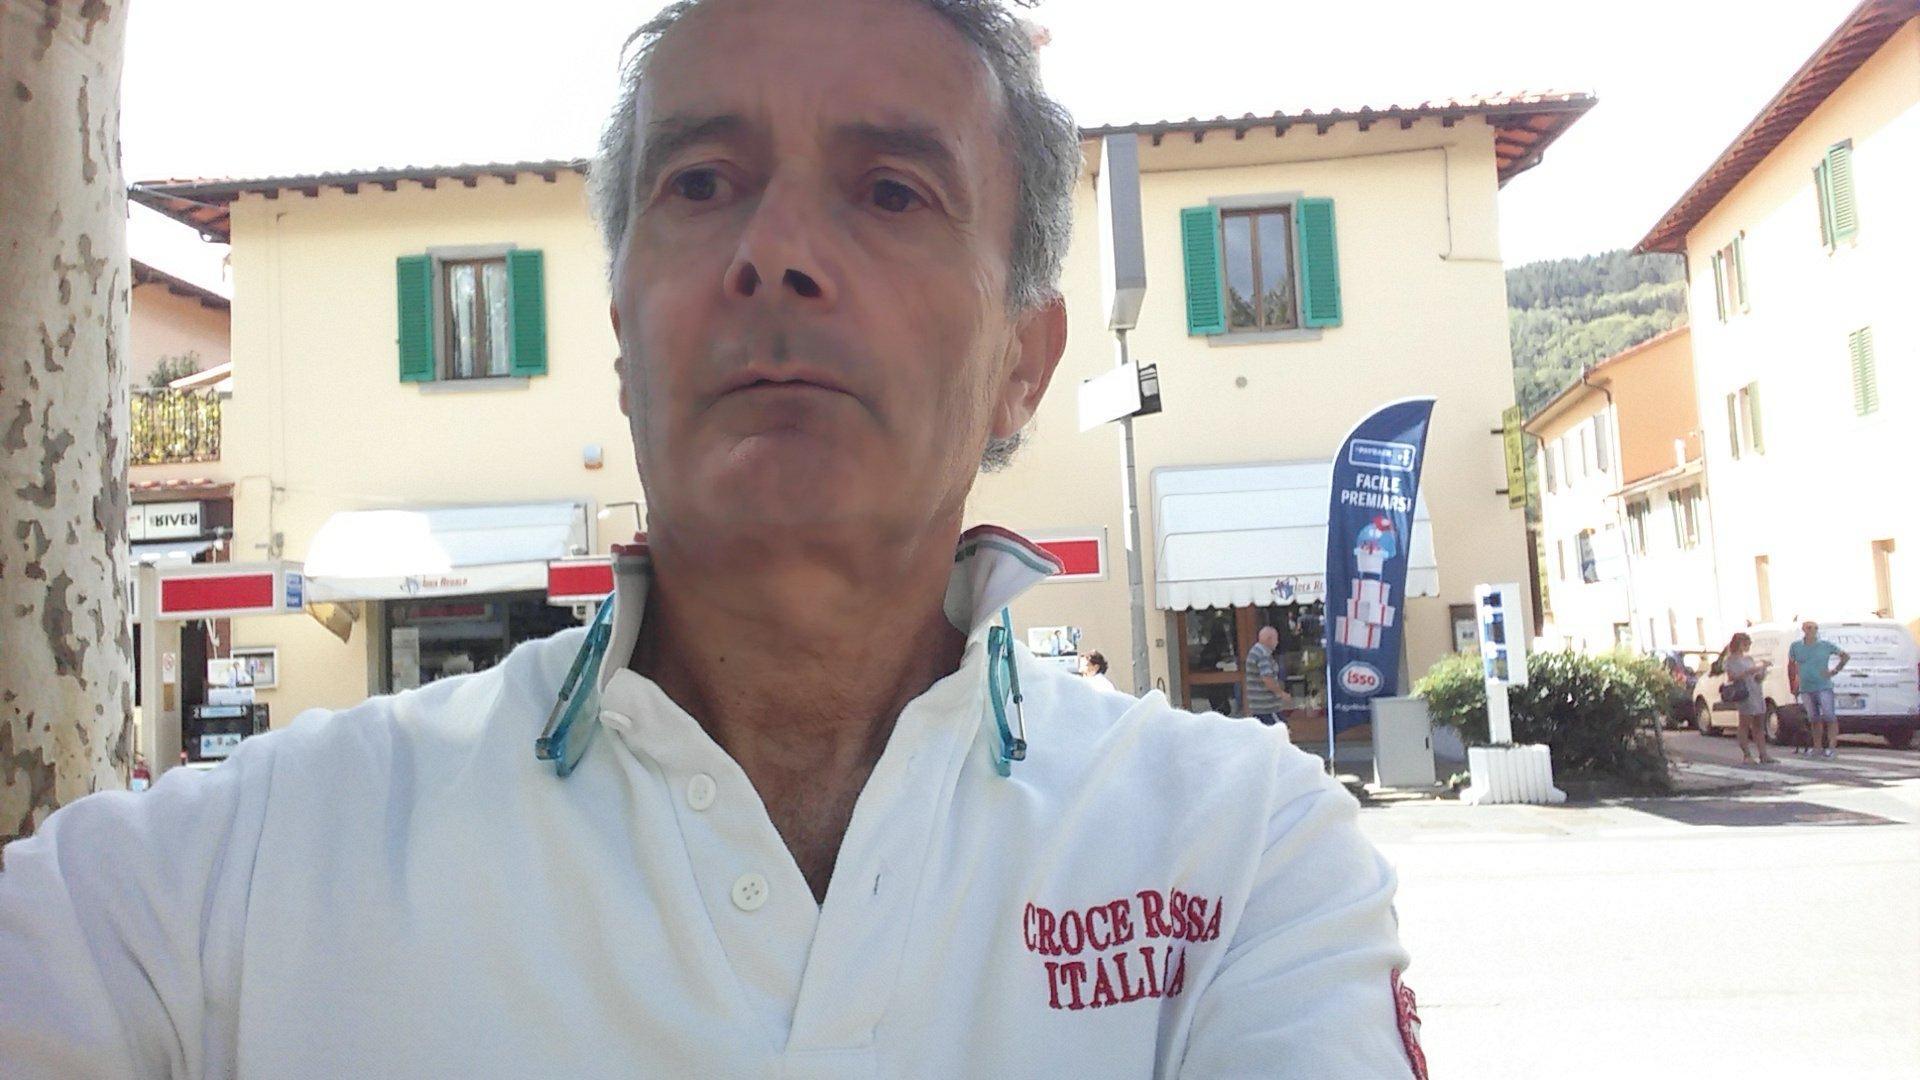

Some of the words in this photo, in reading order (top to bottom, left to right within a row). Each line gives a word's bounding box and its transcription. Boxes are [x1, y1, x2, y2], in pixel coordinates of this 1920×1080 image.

[1355, 473, 1401, 494] FACILE
[1024, 899, 1134, 956] CROCE
[1136, 887, 1223, 943] RSSA
